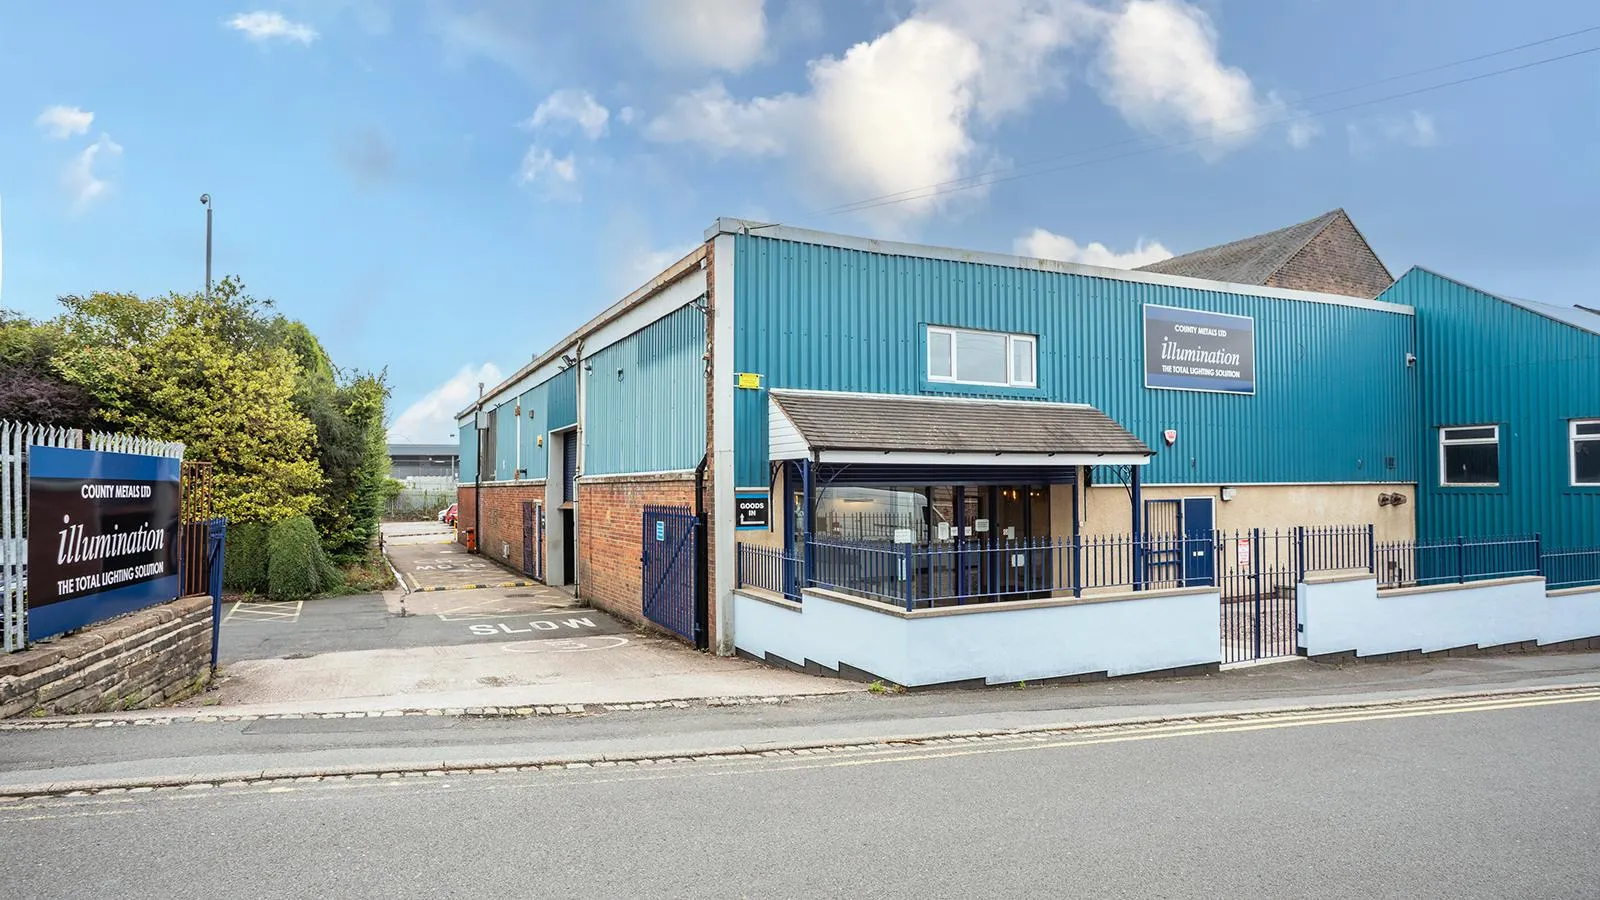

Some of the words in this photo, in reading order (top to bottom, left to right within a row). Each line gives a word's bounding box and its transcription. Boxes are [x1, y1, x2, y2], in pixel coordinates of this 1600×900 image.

[1174, 324, 1198, 334] COUNTY
[1198, 326, 1217, 336] METALS
[1218, 329, 1227, 337] LTD
[1161, 336, 1240, 366] illumination
[1162, 364, 1172, 373] THE
[1173, 365, 1189, 374] TOTAL
[1190, 367, 1214, 376] LIGHTING
[1215, 369, 1240, 378] SOLUTION
[81, 484, 114, 499] COUNTY
[115, 484, 140, 499] METALS
[141, 485, 152, 498] LTD
[57, 514, 165, 566] illumination
[57, 578, 74, 596] THE
[75, 573, 101, 592] TOTAL
[102, 567, 134, 586] LIGHTING
[135, 561, 164, 579] SOLUTION
[468, 617, 597, 636] SLOW
